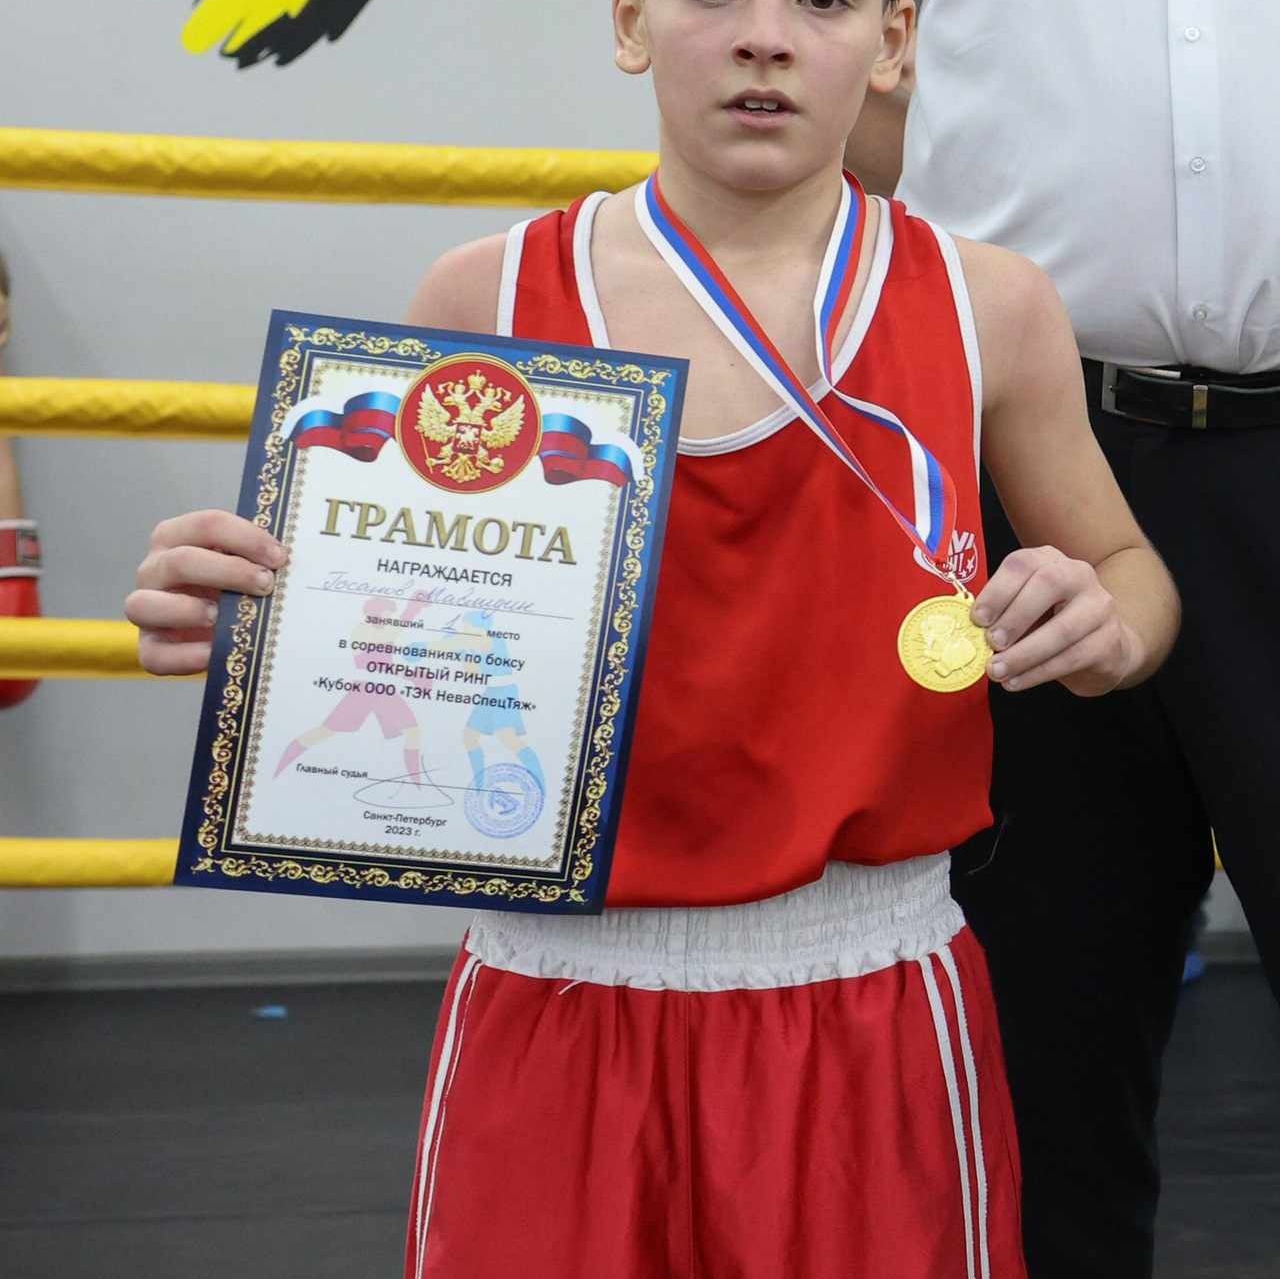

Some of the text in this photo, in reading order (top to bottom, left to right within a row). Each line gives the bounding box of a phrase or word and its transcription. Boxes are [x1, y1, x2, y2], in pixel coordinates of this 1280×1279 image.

[319, 498, 578, 565] ГРАМОТА
[377, 558, 513, 587] НАГРАЖДАЕТСЯ
[365, 614, 424, 630] занявший
[486, 629, 521, 641] место
[339, 639, 526, 671] в соревнованиях по боксу
[367, 661, 492, 686] ОТКРЫТЫЙ РИНГ
[365, 682, 396, 696] ООО
[436, 689, 537, 711] НеваСпецТяж»
[296, 763, 368, 779] Главный судья
[363, 810, 447, 827] Санкт-Петербург
[385, 825, 421, 837] 2023 г.
